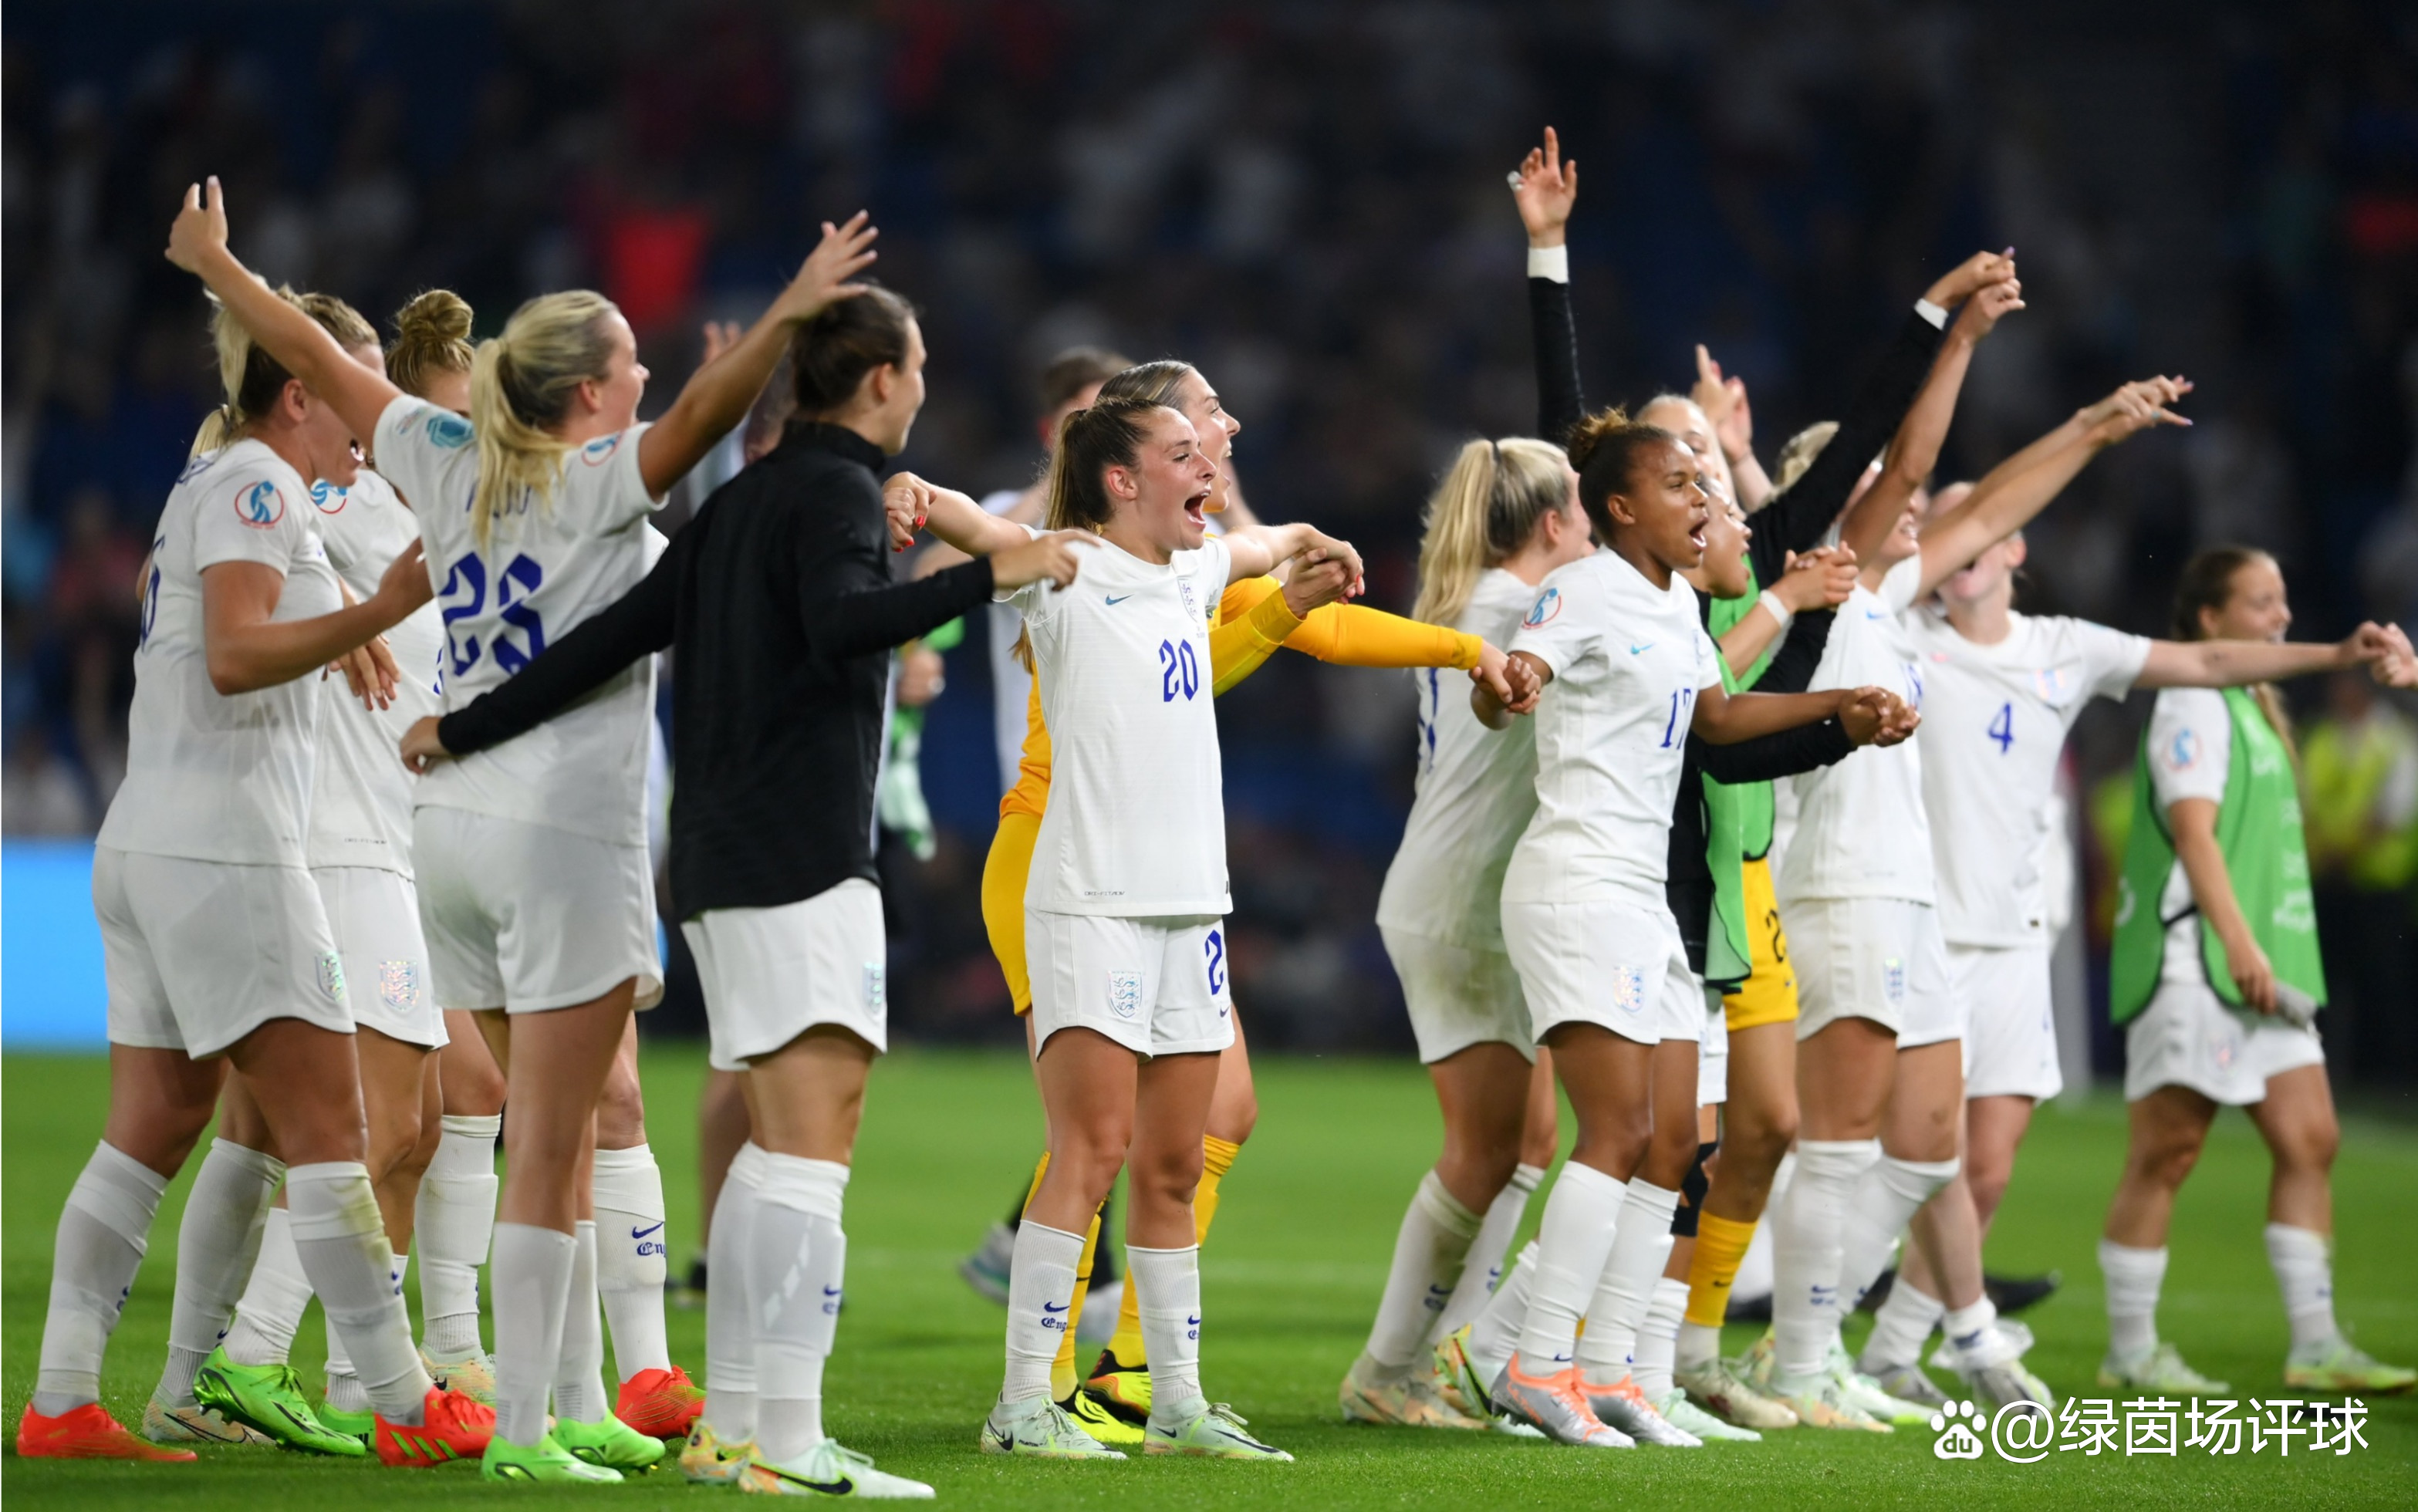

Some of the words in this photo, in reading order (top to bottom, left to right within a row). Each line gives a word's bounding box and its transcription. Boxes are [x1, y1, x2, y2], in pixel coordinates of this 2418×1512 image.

[1159, 639, 1198, 702] 20
[1660, 689, 1691, 750] 17
[1988, 703, 2014, 754] 4
[1205, 930, 1224, 995] 2
